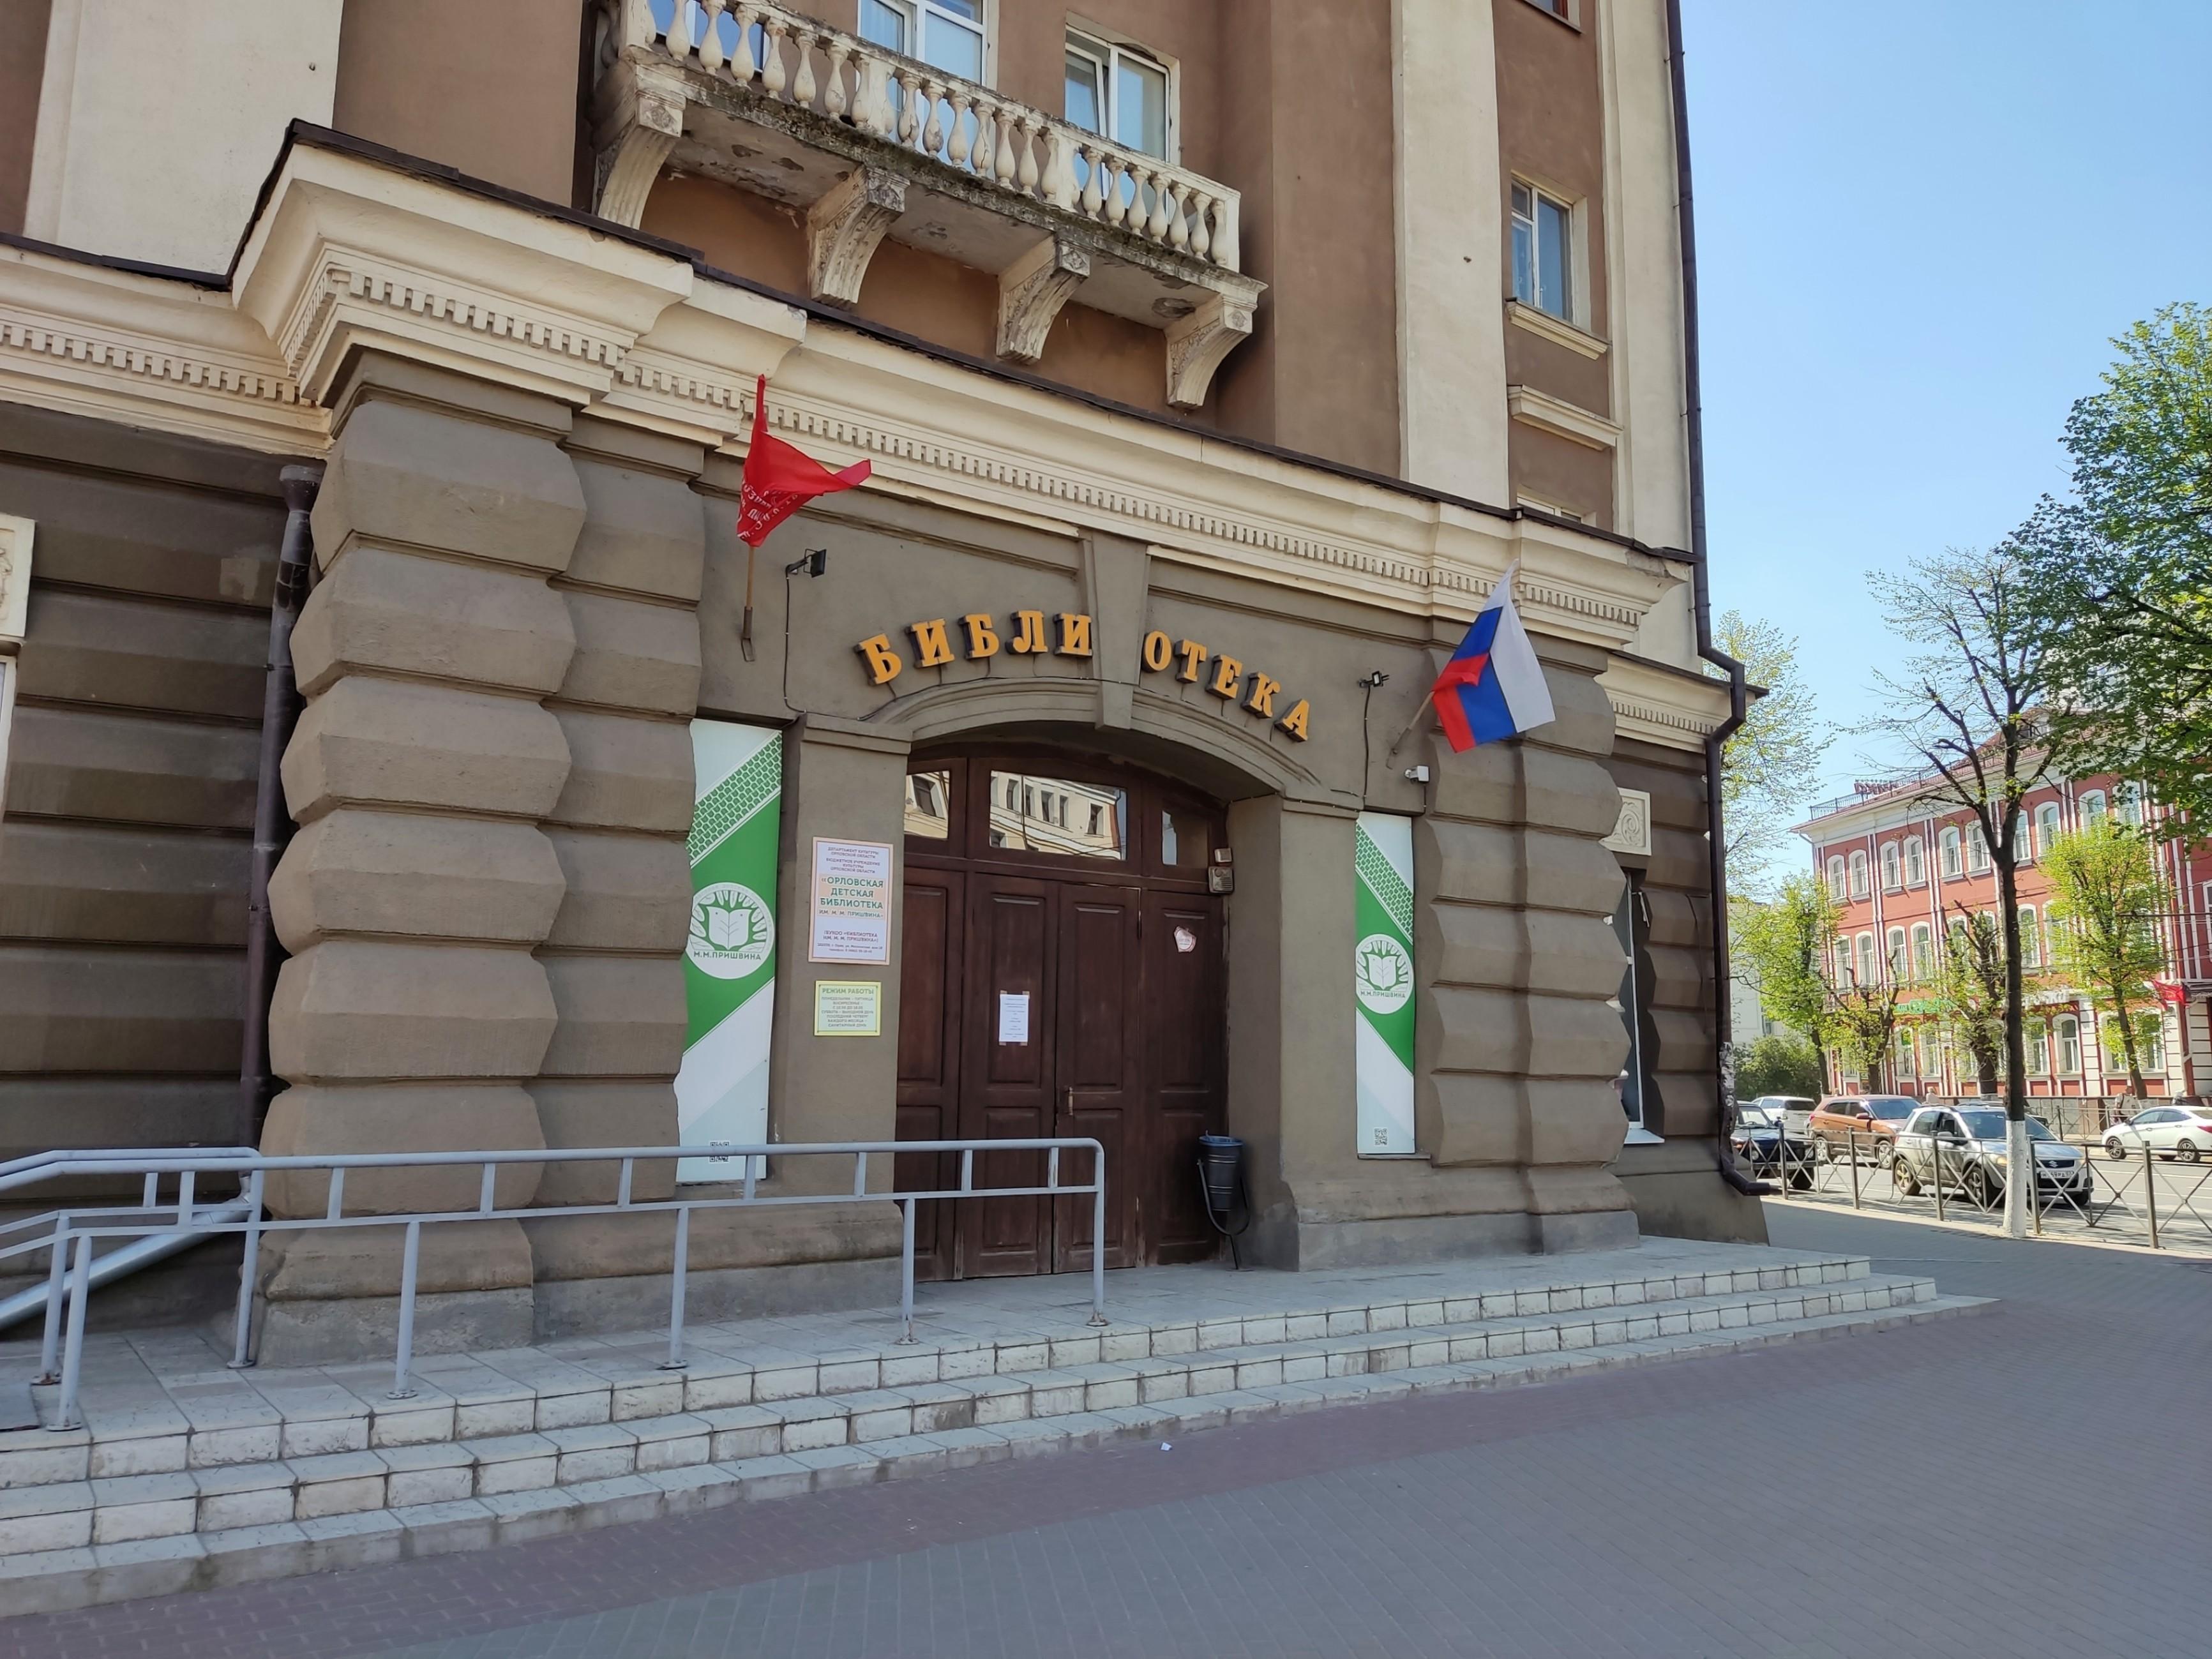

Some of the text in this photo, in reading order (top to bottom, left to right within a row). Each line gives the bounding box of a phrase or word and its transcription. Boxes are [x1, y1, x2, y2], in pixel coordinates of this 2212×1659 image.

[821, 876, 884, 888] «ОРЛОВСКАЯ
[831, 887, 874, 897] ДЕТСКАЯ
[820, 897, 884, 909] БИБЛИОТЕКА
